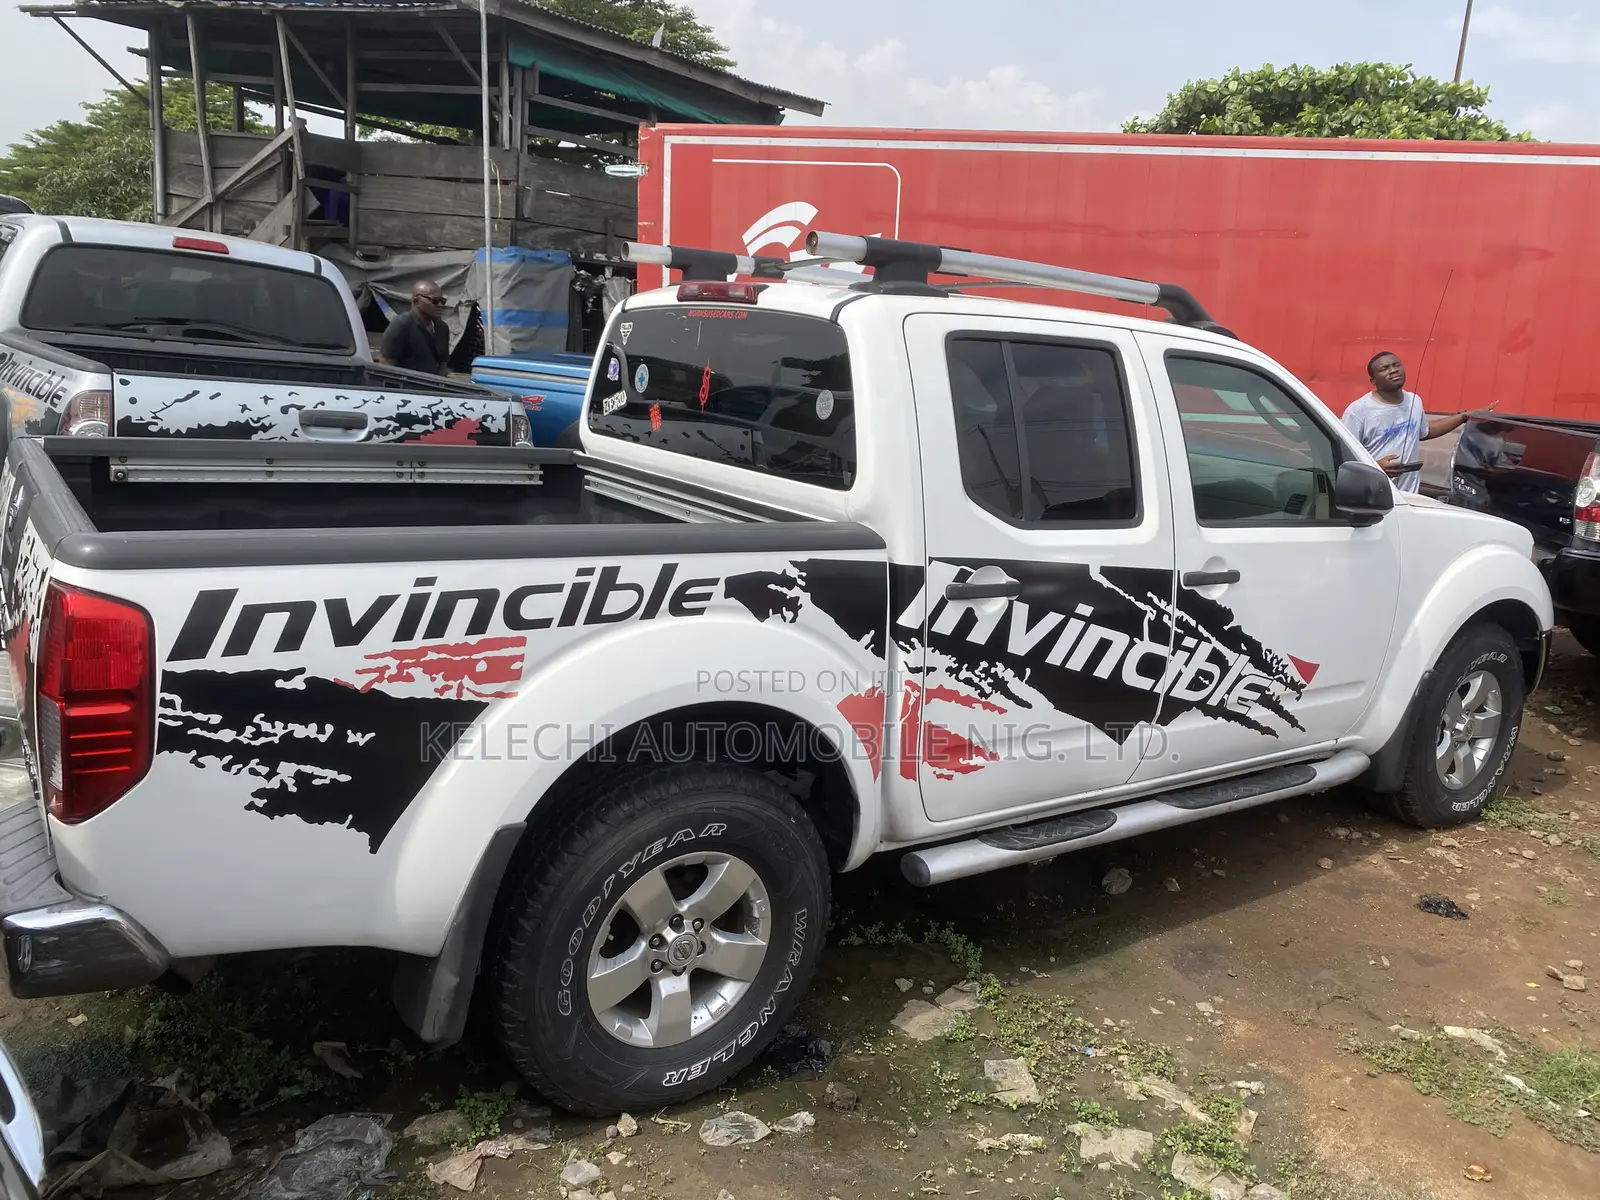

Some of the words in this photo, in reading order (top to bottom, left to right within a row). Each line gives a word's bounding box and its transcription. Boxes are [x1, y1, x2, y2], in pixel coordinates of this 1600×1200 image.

[166, 563, 721, 662] Invincible
[896, 559, 1274, 716] Invincible
[662, 908, 808, 1087] WRANGLER
